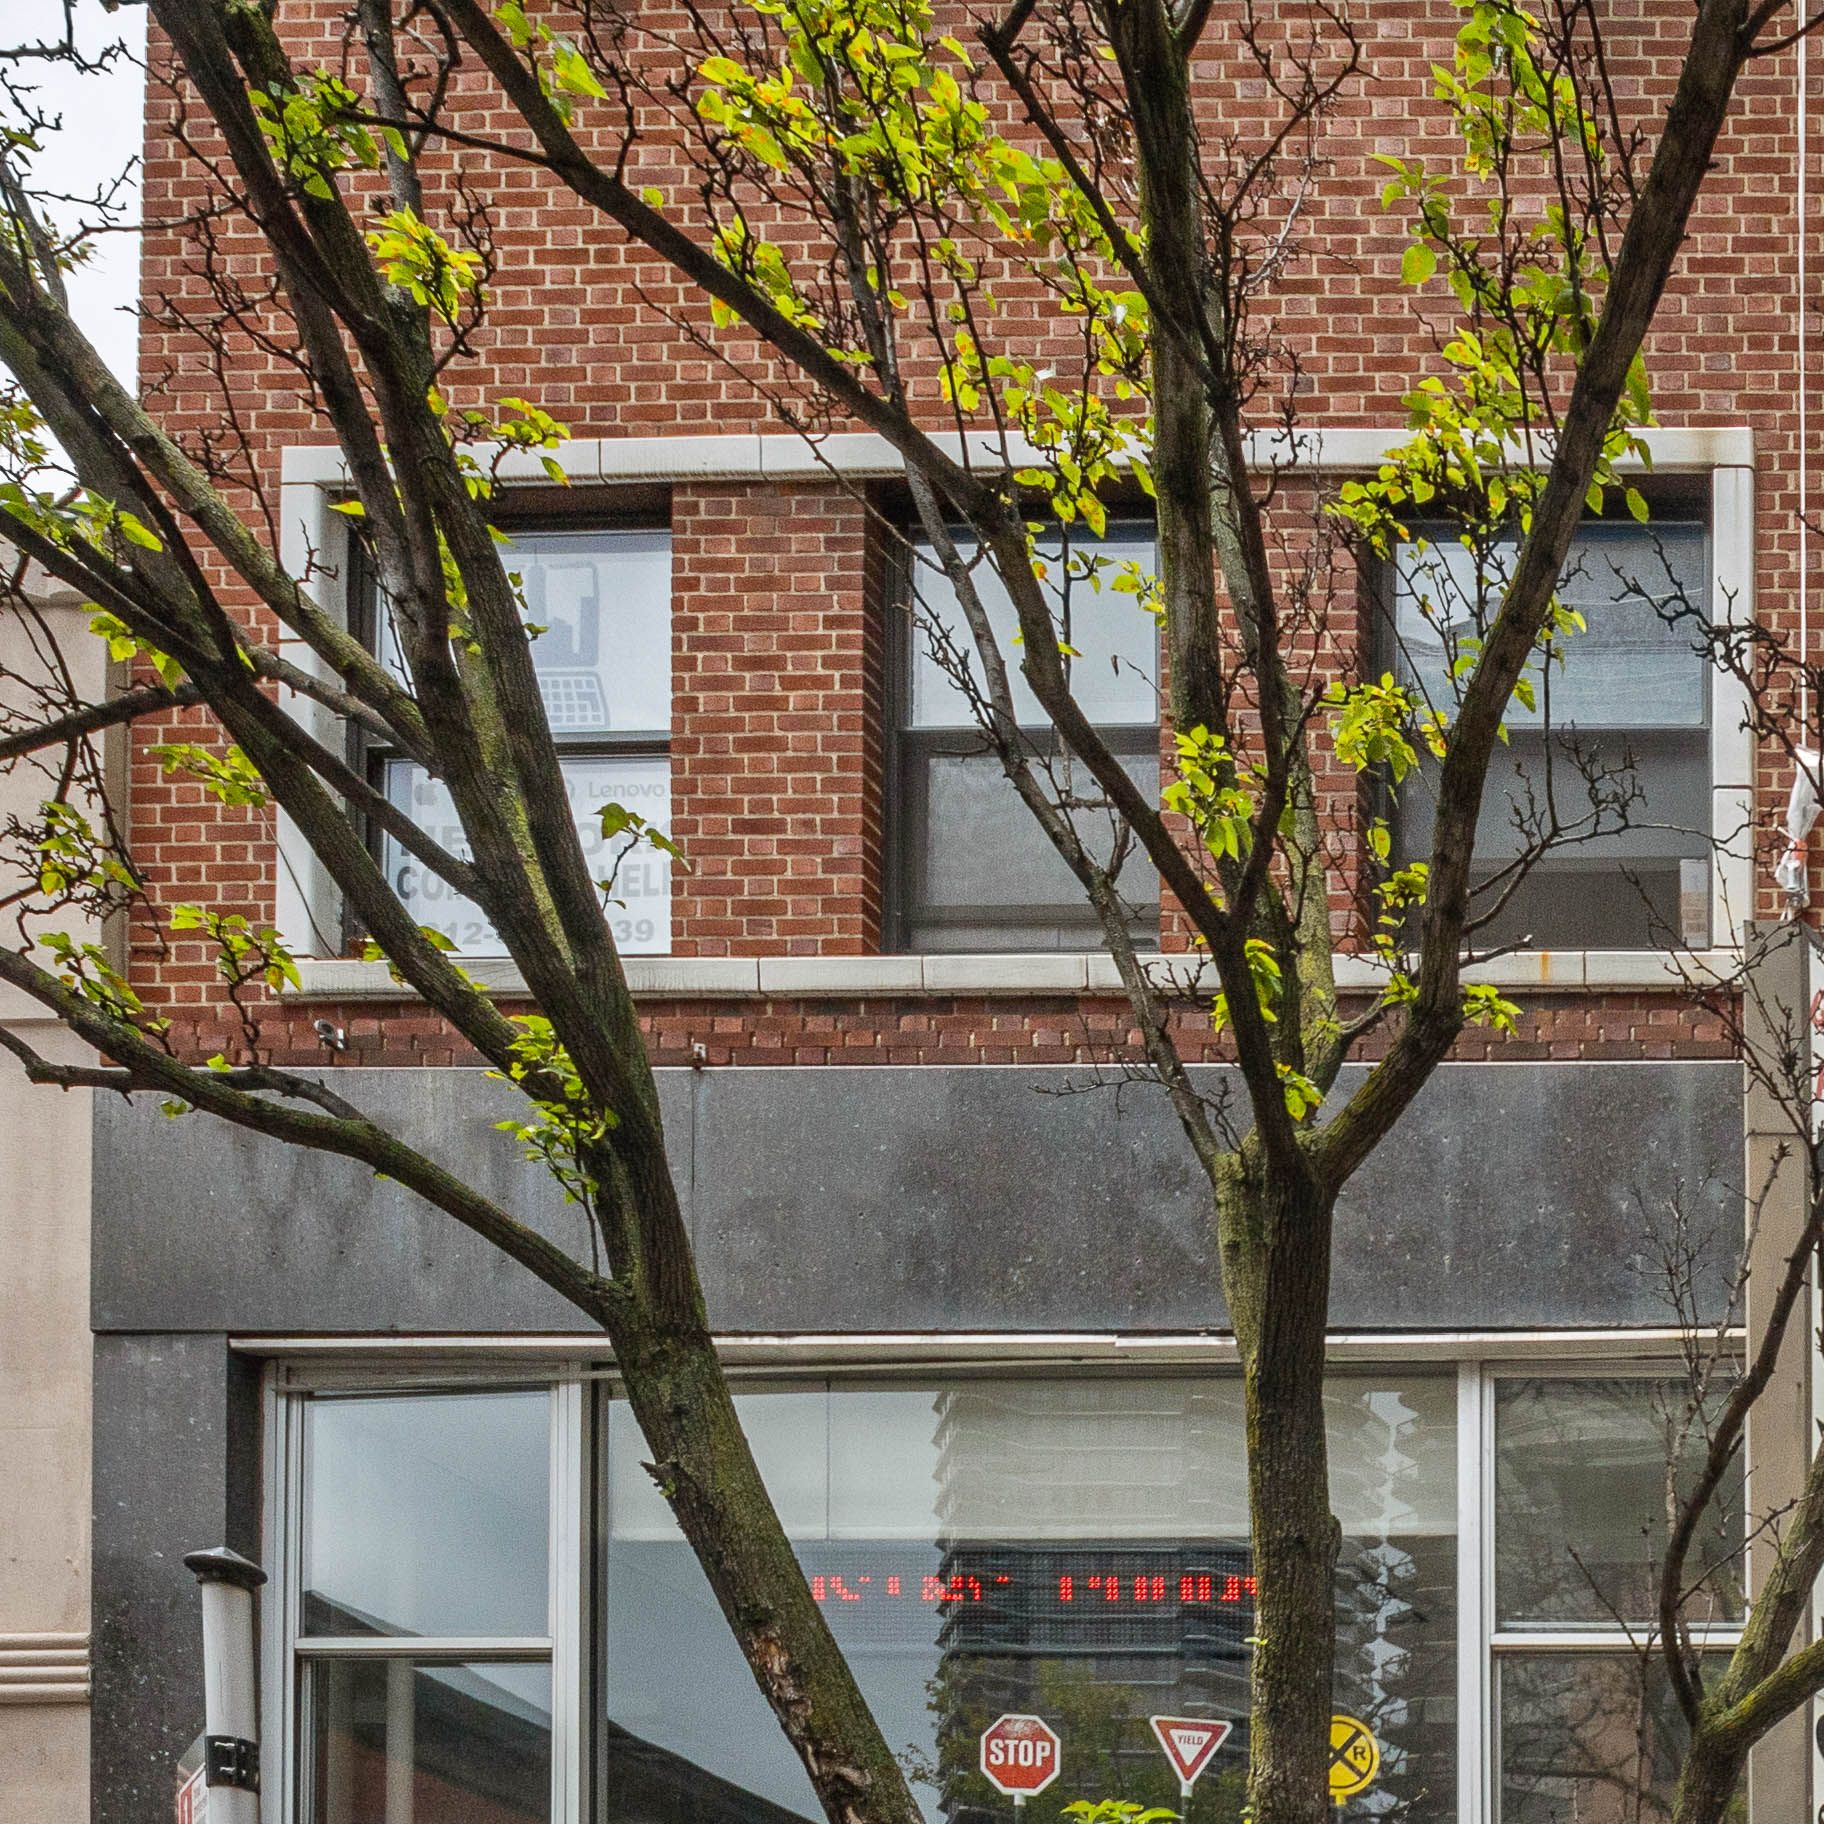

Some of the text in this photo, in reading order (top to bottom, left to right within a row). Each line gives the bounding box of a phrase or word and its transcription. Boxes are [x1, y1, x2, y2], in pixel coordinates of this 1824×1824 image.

[588, 781, 665, 799] Lenovo
[1177, 1734, 1204, 1747] YIELD
[988, 1739, 1052, 1768] STOP
